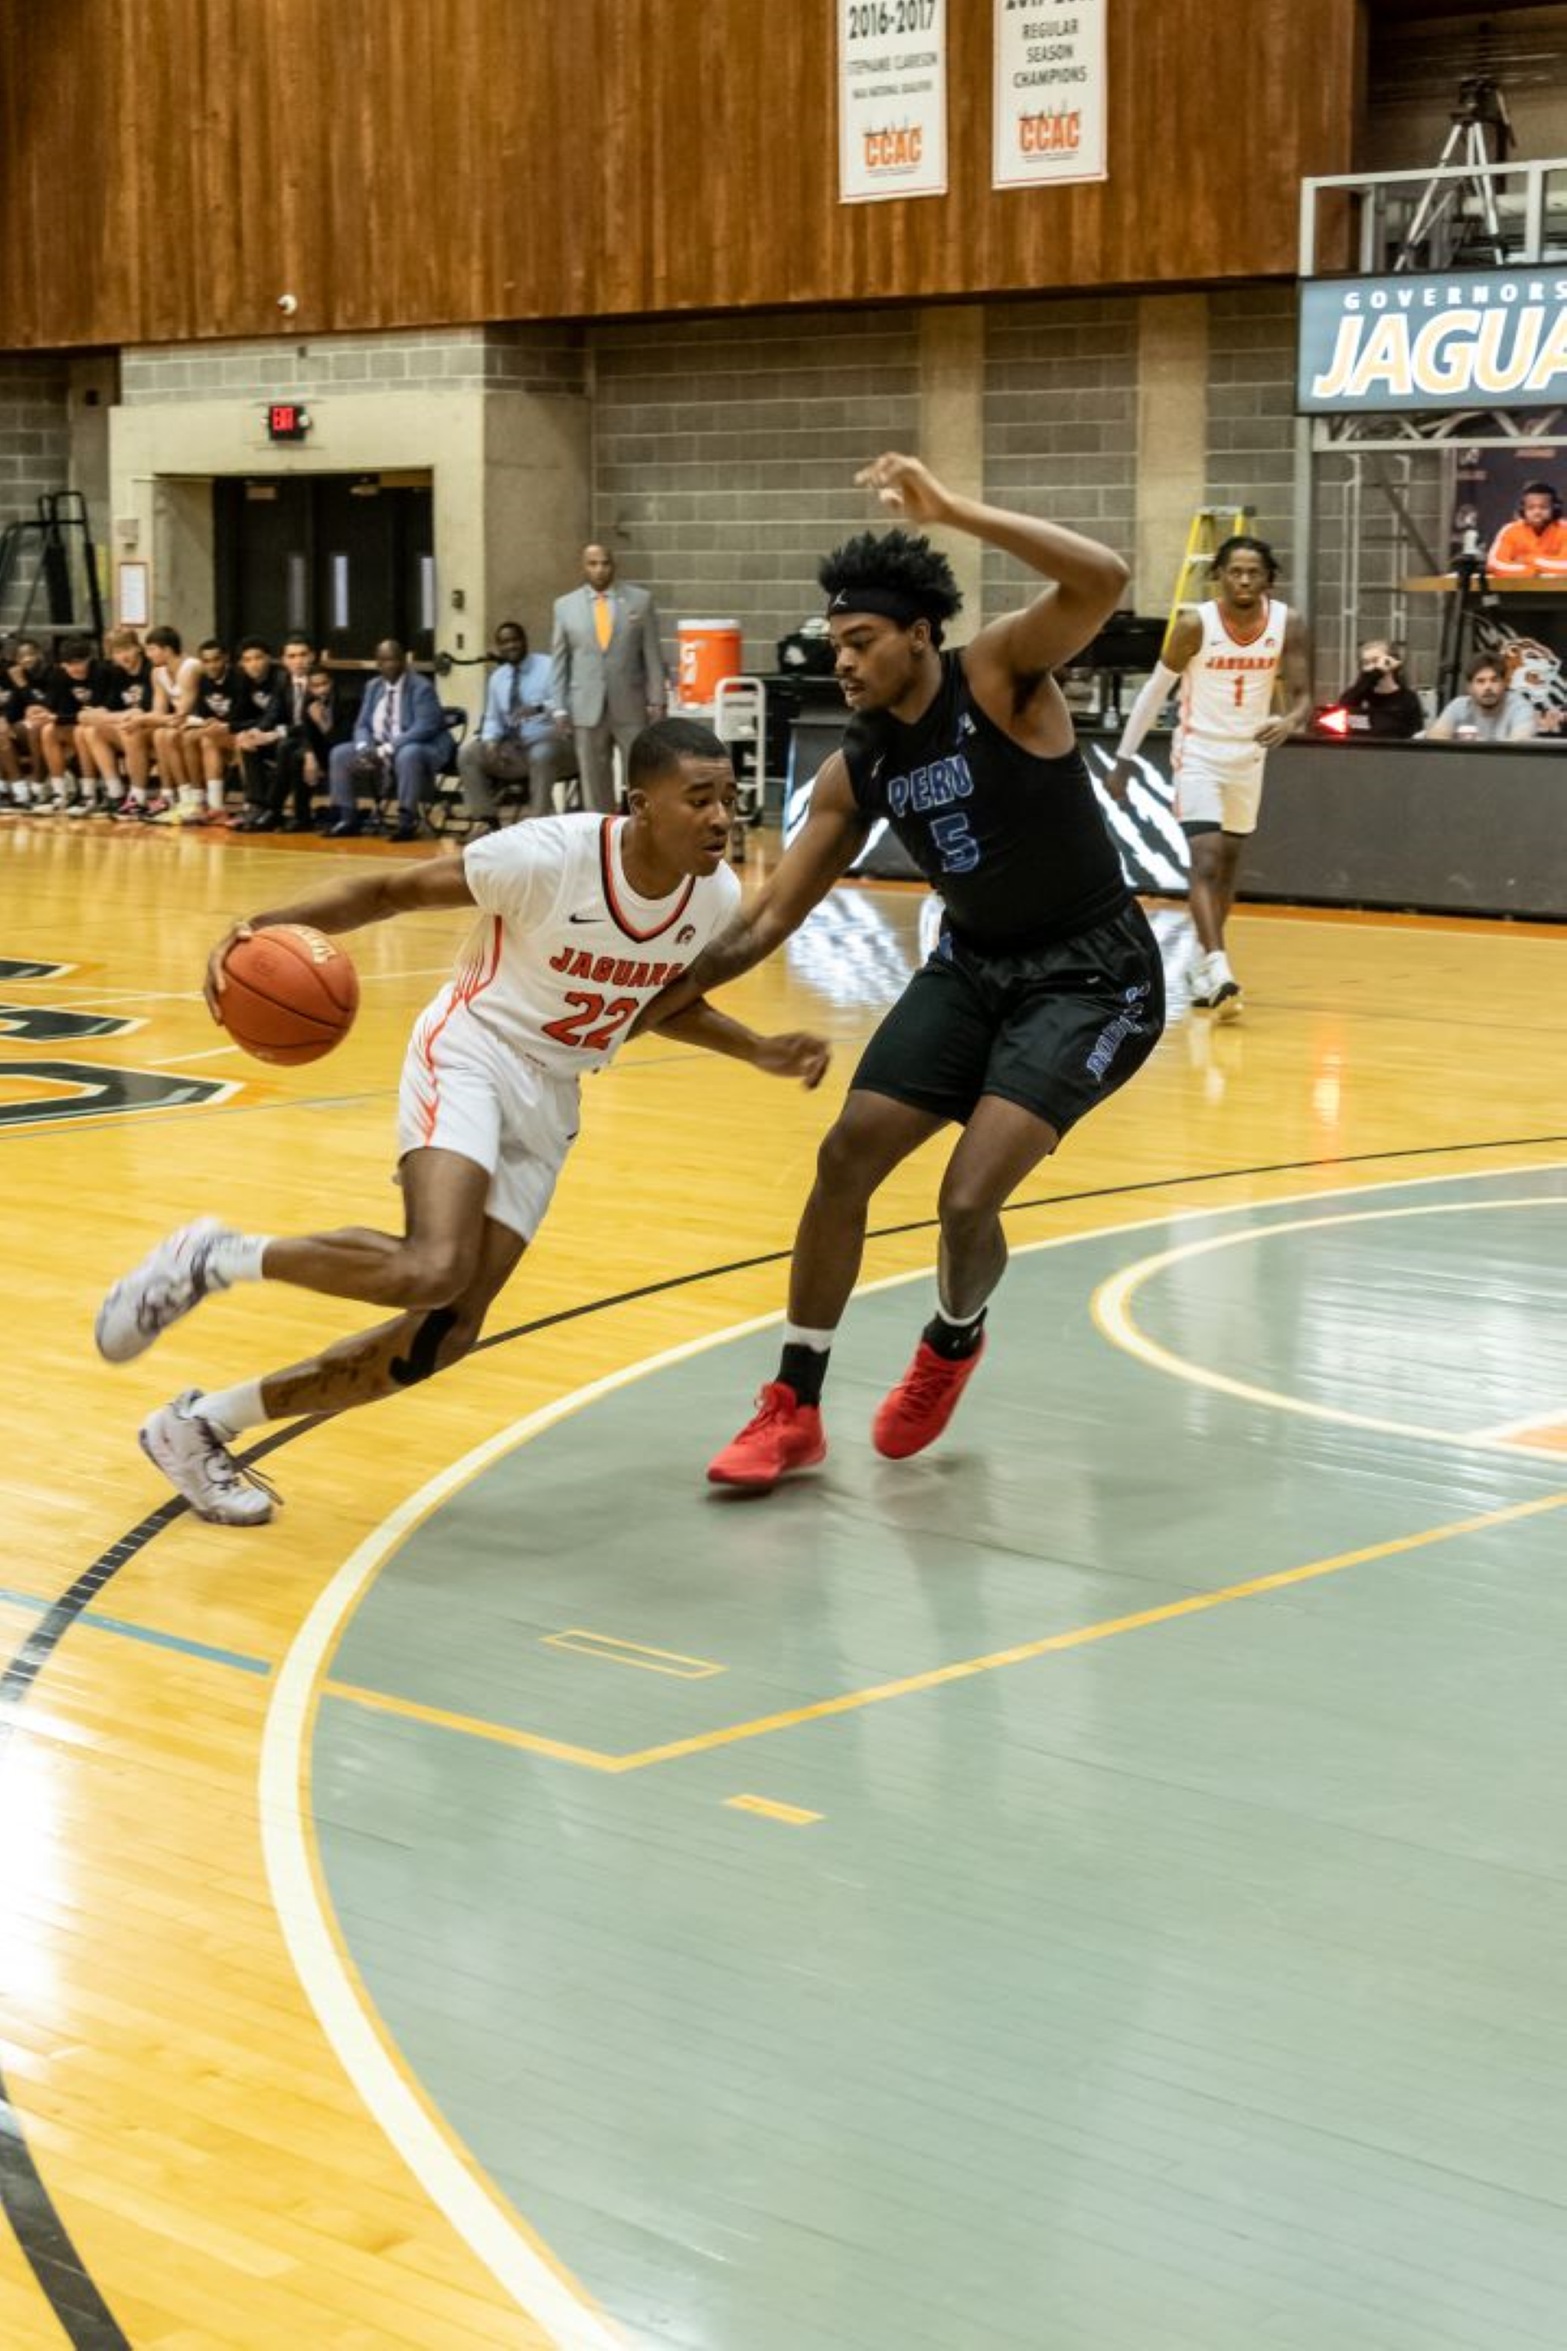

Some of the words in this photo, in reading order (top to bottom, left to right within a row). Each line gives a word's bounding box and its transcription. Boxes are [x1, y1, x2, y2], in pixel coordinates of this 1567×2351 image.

[848, 0, 936, 39] 2016-2017
[1022, 18, 1078, 40] REGULAR
[1026, 44, 1073, 63] SEASON
[1013, 66, 1086, 89] CHAMPIONS
[864, 127, 922, 167] CCAC
[1019, 113, 1079, 152] CCAC
[1344, 281, 1567, 309] GOVERNORS
[272, 407, 294, 430] EXIT
[1233, 675, 1245, 707] 1
[888, 754, 975, 818] PERU
[930, 812, 980, 873] 5
[541, 991, 639, 1051] 22
